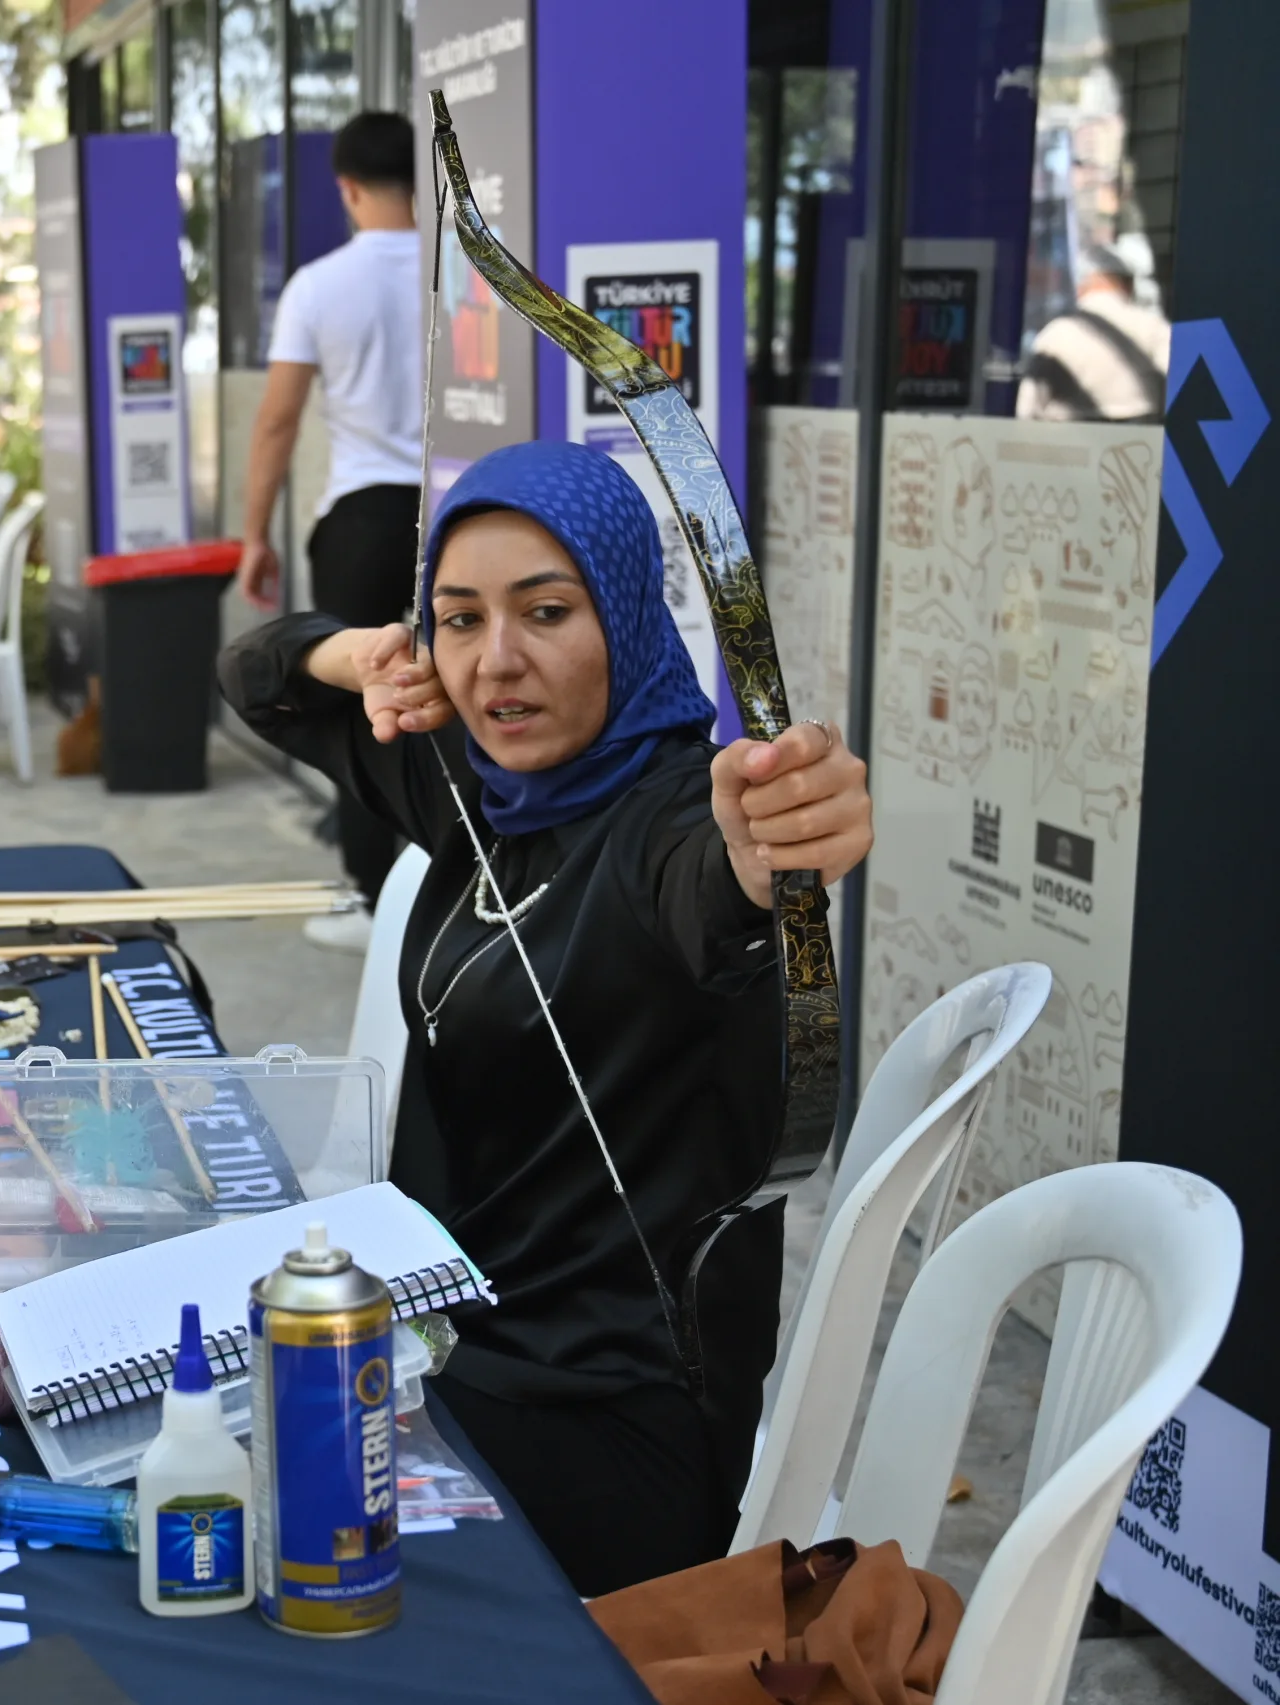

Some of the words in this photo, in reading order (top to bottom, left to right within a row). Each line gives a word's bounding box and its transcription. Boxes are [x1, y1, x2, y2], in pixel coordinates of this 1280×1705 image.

[594, 279, 692, 306] TÜRKİYE
[1032, 872, 1093, 916] unesco
[361, 1405, 393, 1518] STERN
[193, 1535, 213, 1580] STERN
